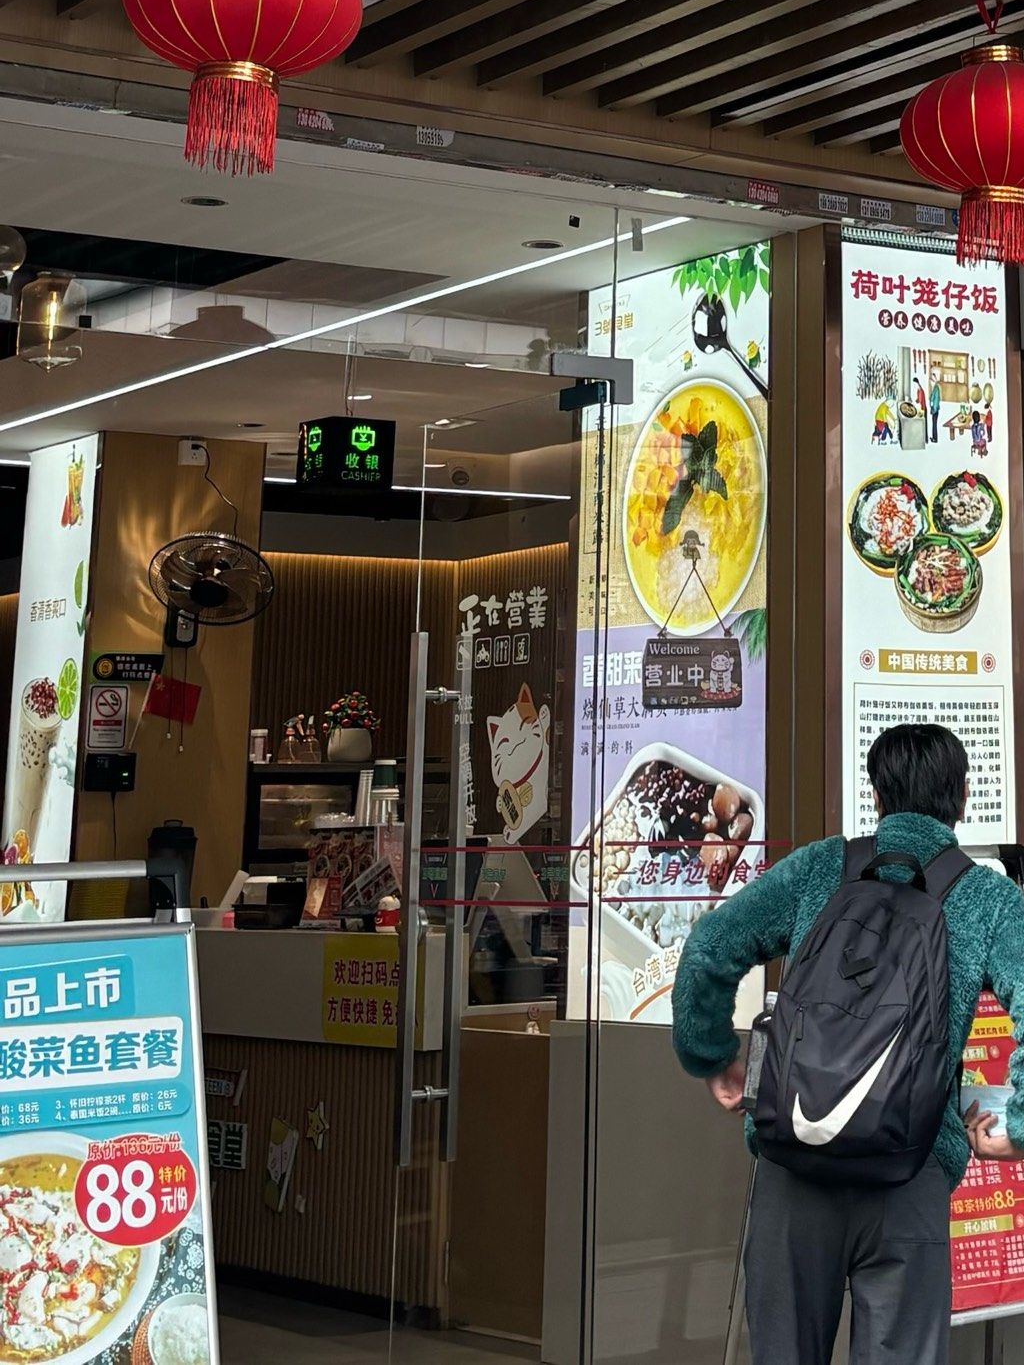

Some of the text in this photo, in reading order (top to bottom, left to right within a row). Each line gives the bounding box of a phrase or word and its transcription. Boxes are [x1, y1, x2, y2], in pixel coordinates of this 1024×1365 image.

[850, 269, 999, 314] 荷叶笼仔饭
[650, 642, 700, 656] Welcome
[888, 652, 969, 672] 中国传统美食
[645, 664, 705, 688] 营业中
[4, 967, 121, 1020] 品上市
[0, 1029, 178, 1081] 酸菜鱼套餐
[86, 1159, 188, 1233] 88 特价
[160, 1187, 188, 1214] 元/份
